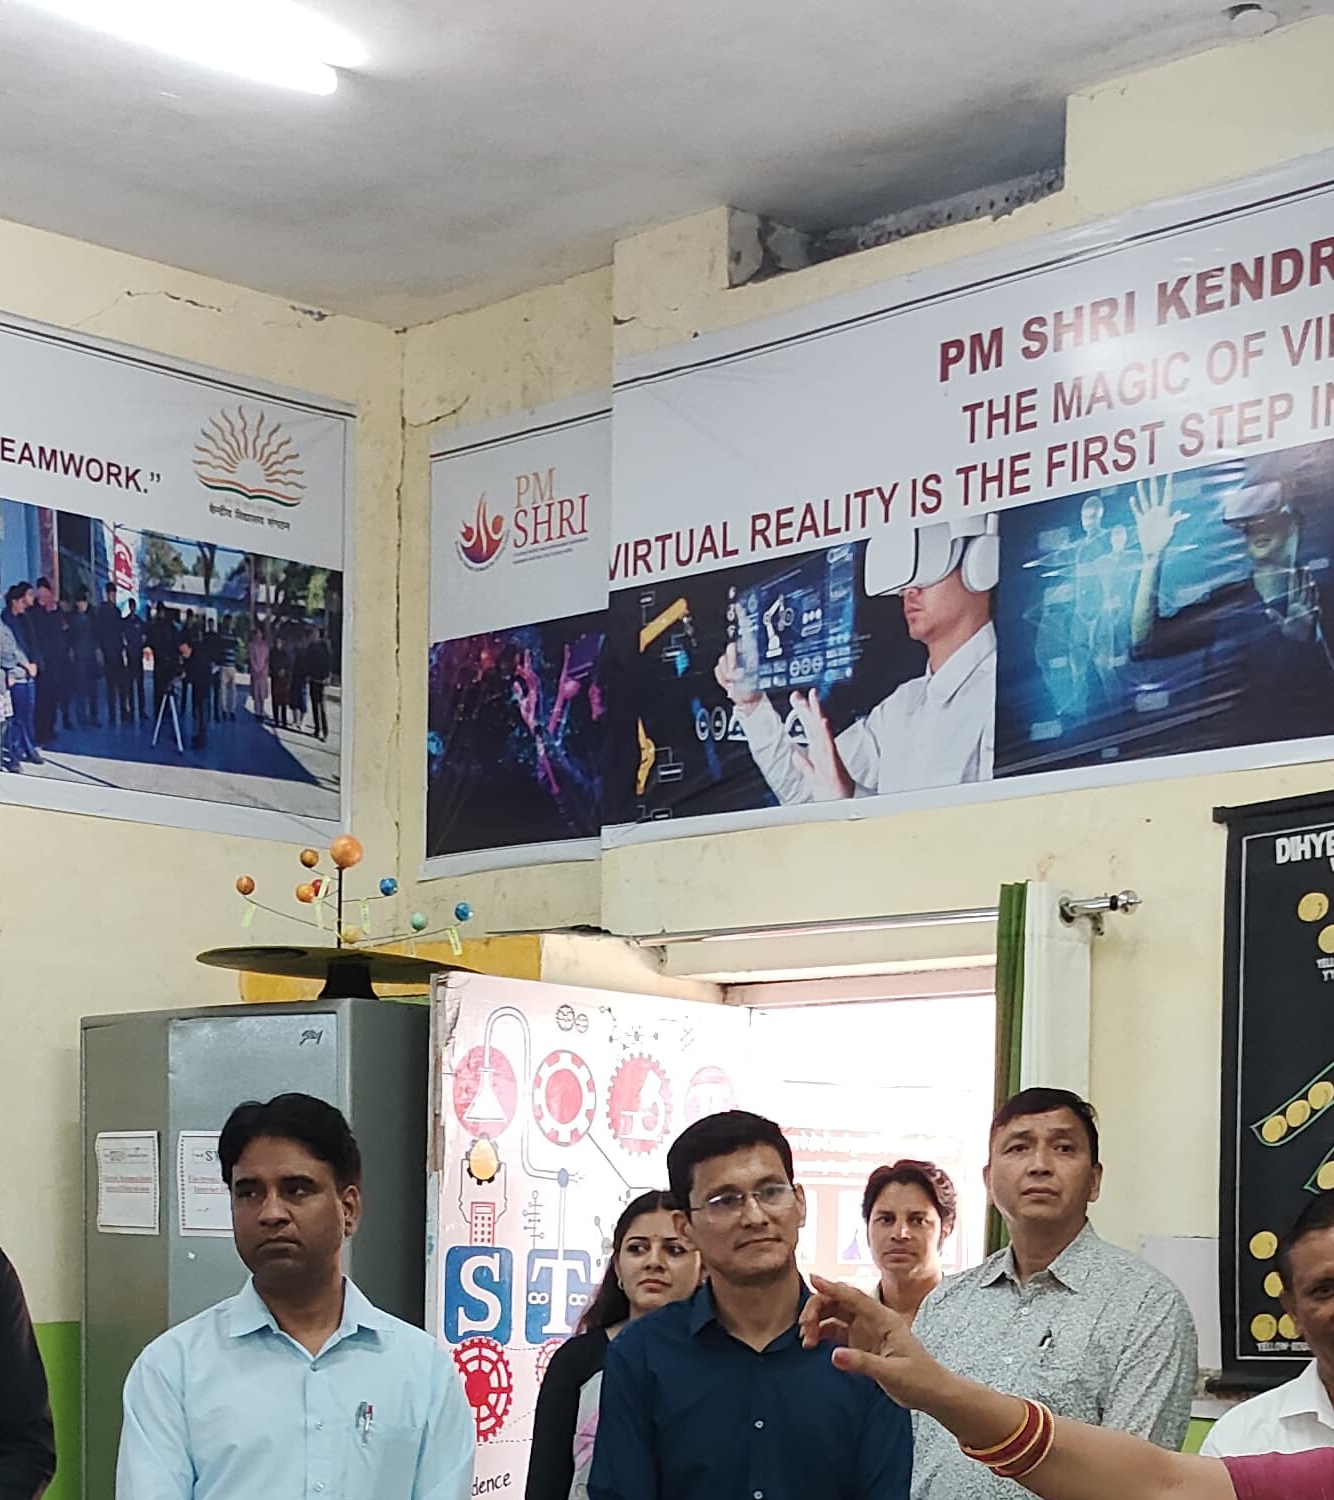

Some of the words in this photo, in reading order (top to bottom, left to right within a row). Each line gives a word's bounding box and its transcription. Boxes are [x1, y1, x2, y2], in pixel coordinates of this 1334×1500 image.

[939, 326, 1004, 383] PM
[1020, 292, 1136, 362] SHRI
[961, 391, 1037, 446] THE
[1052, 352, 1190, 420] MAGIC
[1206, 331, 1265, 383] OF
[513, 494, 589, 549] SHRI
[515, 468, 556, 508] PM
[606, 520, 739, 581] VIRTUAL
[748, 483, 899, 550] REALITY
[909, 473, 944, 519] IS
[955, 453, 1028, 505] THE
[1044, 419, 1164, 489] FIRST
[1178, 391, 1294, 459] STEP
